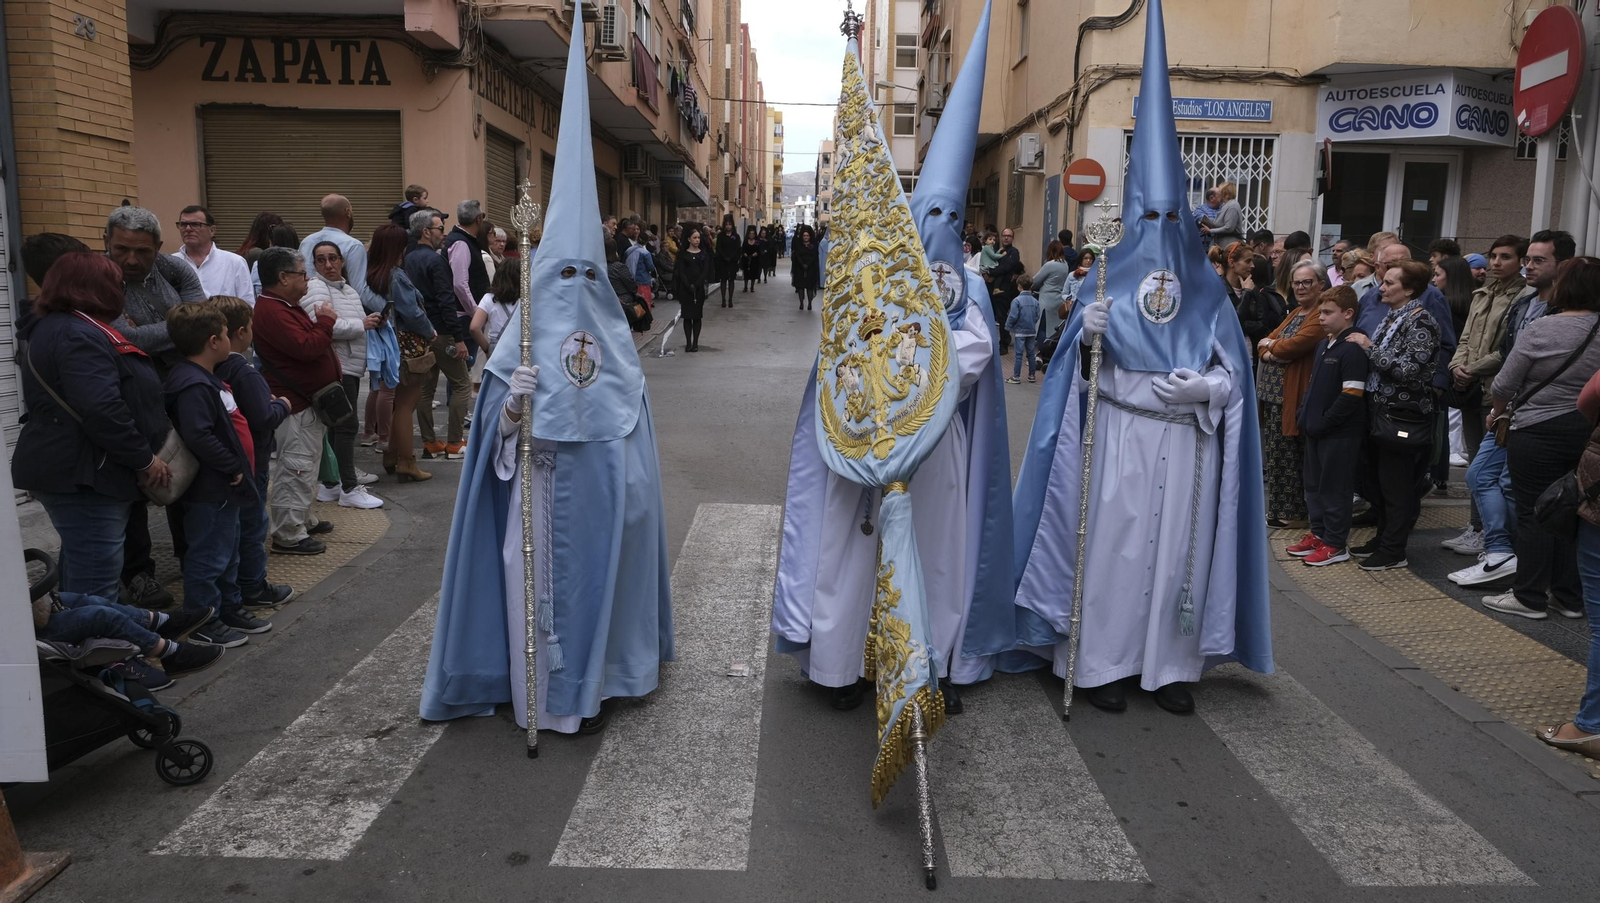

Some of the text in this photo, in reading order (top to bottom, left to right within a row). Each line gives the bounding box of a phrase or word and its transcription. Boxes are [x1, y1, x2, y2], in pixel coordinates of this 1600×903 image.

[73, 13, 96, 40] 29
[200, 36, 391, 86] ZAPATA
[1325, 83, 1446, 102] AUTOESCUELA
[1455, 84, 1514, 107] AUTOESCUELA
[541, 99, 560, 139] ZAP
[1173, 101, 1203, 116] Estudios
[1328, 102, 1439, 133] CANO
[1456, 104, 1510, 137] CANO
[857, 255, 874, 270] INRI
